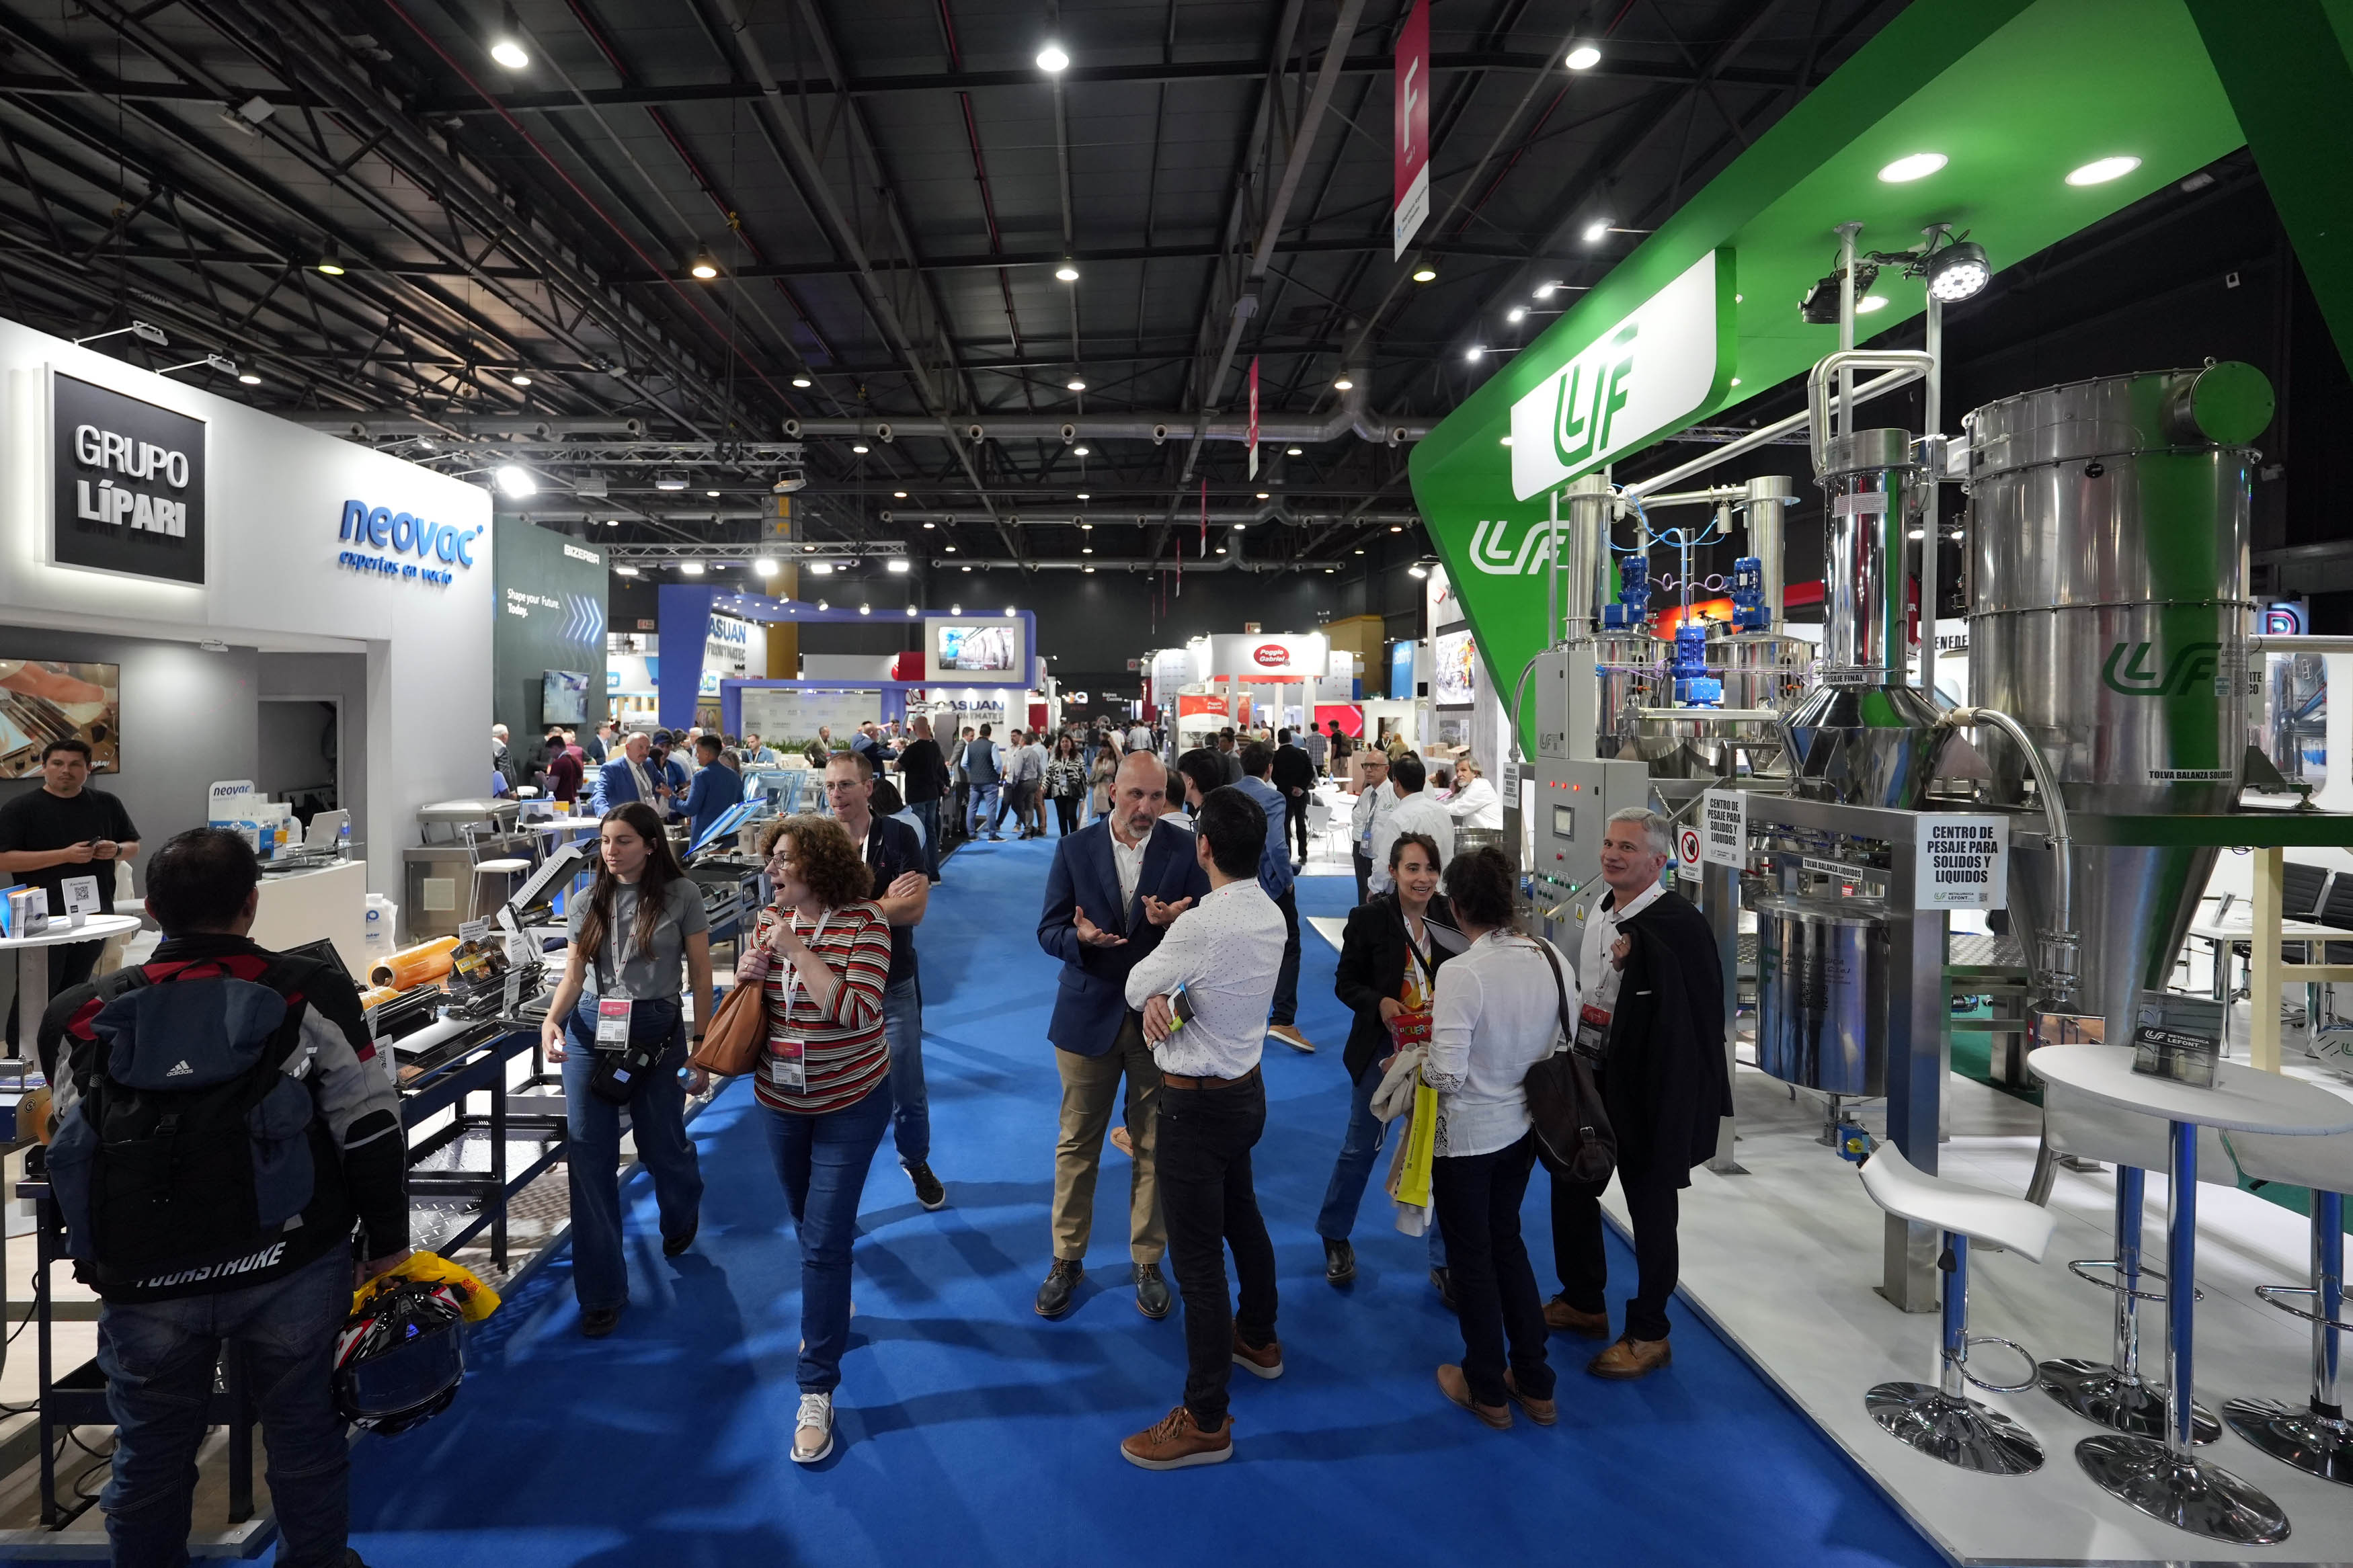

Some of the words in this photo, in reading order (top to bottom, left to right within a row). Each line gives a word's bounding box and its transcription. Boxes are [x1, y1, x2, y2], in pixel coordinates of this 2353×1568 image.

[1403, 56, 1419, 153] F
[75, 425, 189, 488] GRUPO
[77, 479, 186, 538] LÍPARI
[340, 500, 476, 565] neovac
[564, 544, 600, 565] BIZERBA
[340, 551, 399, 574] expertos
[403, 565, 417, 577] en
[422, 567, 452, 583] vacío
[508, 588, 526, 603] Shape
[526, 594, 540, 605] your
[542, 595, 559, 609] Future.
[508, 603, 528, 618] Today.
[2149, 771, 2174, 779] TOLVA
[2209, 771, 2232, 779] SOLIDOS
[1710, 798, 1730, 810] CENTRO
[1732, 802, 1739, 811] DE
[1708, 809, 1726, 821] PESAJE
[1726, 812, 1741, 823] PARA
[1710, 821, 1732, 834] SOLIDOS
[1734, 825, 1737, 834] Y
[1933, 826, 1977, 839] CENTRO
[1979, 827, 1993, 839] DE
[1711, 832, 1736, 846] LIQUIDOS
[1927, 841, 1966, 853] PESAJE
[1969, 841, 1998, 853] PARA
[1683, 864, 1698, 872] PROHIBIDO
[1804, 860, 1817, 868] TOLVA
[1819, 862, 1838, 873] BALANZA
[1839, 868, 1862, 878] LIQUIDOS
[1933, 856, 1981, 868] SOLIDOS
[1984, 856, 1991, 868] Y
[1936, 870, 1988, 884] LIQUIDOS
[2167, 1038, 2200, 1048] LEFONT
[2168, 1034, 2209, 1044] METALURGICA
[167, 1067, 194, 1077] adidas
